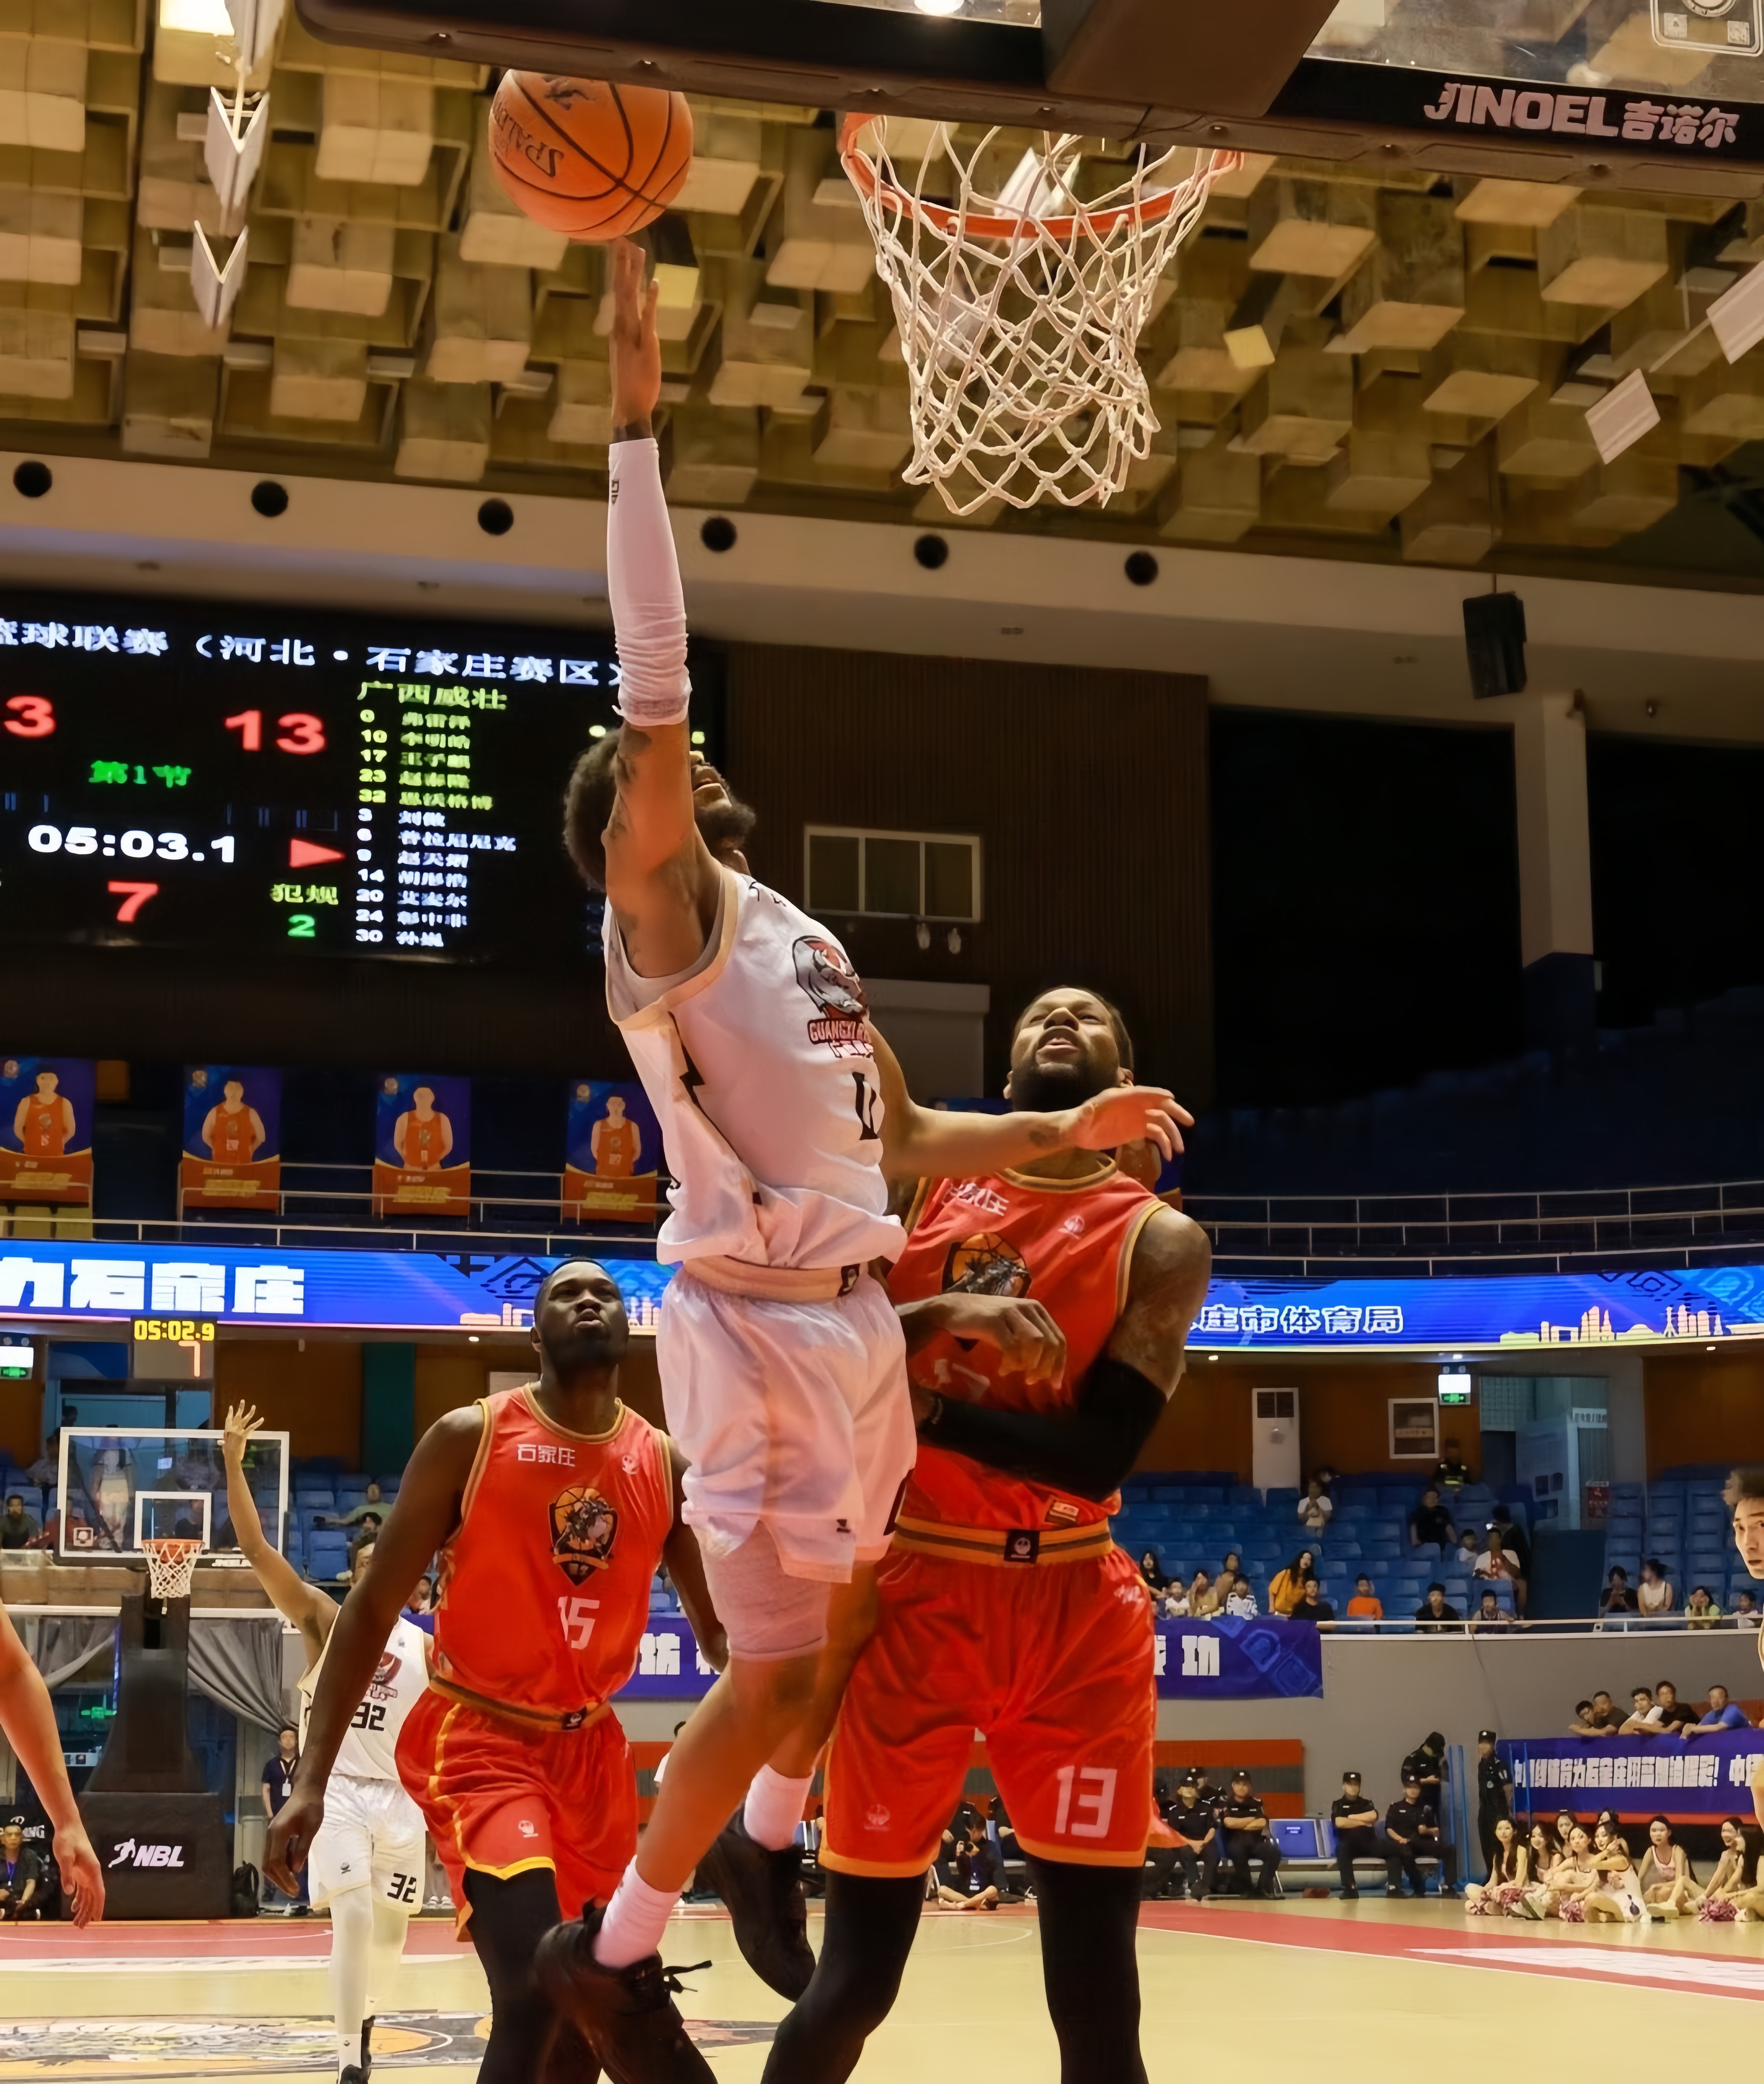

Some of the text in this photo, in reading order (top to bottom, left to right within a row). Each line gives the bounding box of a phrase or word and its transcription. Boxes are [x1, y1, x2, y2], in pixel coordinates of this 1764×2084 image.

[1423, 82, 1740, 148] JINOEL 吉诺尔
[225, 710, 327, 755] 13
[361, 729, 387, 743] 10
[360, 749, 387, 762] 17
[359, 768, 386, 782] 23
[359, 788, 386, 803] 32
[28, 824, 236, 863] 05:03.1
[358, 868, 385, 882] 14
[108, 880, 159, 922] 7
[270, 883, 339, 905] 犯规
[356, 888, 384, 902] 20
[287, 914, 316, 937] 2
[356, 909, 384, 923] 24
[355, 929, 383, 942] 30
[1189, 1304, 1404, 1334] 庄市体育局
[134, 1320, 215, 1341] 05:02.9
[517, 1443, 576, 1467] 石家庄
[557, 1596, 600, 1650] 15
[350, 1701, 386, 1731] 32
[1054, 1765, 1118, 1839] 13
[133, 1845, 184, 1867] NBL
[387, 1872, 416, 1904] 32
